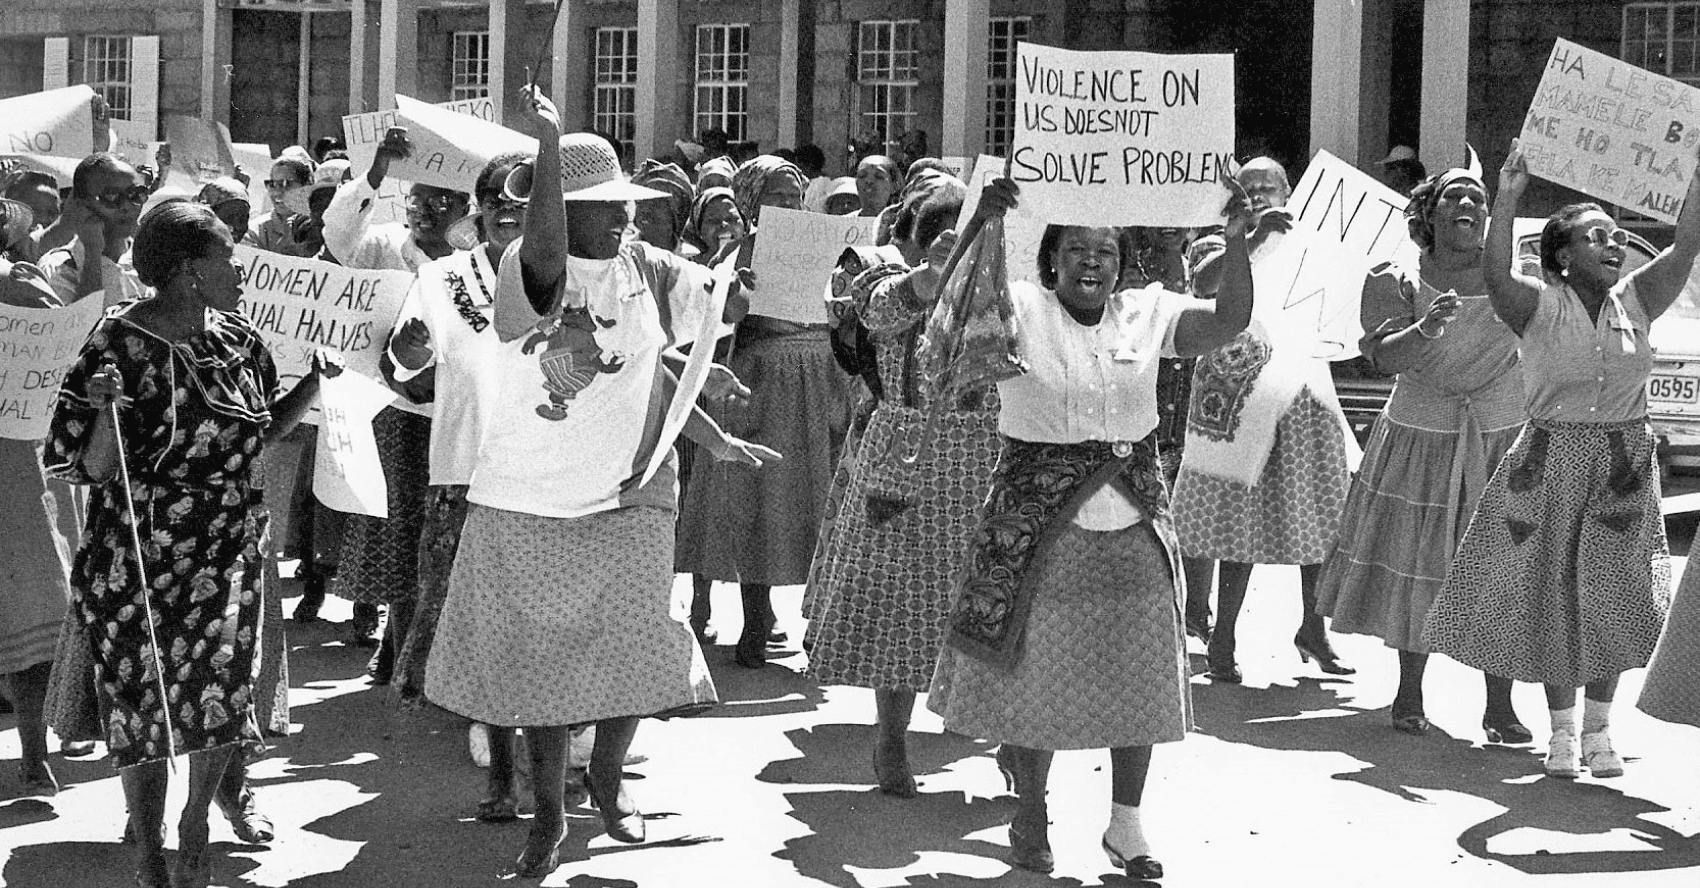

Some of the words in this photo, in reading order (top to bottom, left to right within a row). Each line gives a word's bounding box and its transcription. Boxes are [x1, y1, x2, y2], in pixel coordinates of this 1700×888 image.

[1022, 55, 1147, 103] VIOLENCE
[1162, 69, 1200, 107] ON
[1550, 46, 1585, 80] HA
[1024, 102, 1058, 132] US
[1014, 146, 1108, 186] SOLVE
[1575, 127, 1610, 155] HO
[1630, 141, 1684, 182] TLA
[334, 276, 382, 312] ARE
[294, 308, 374, 352] HALVES
[1650, 377, 1694, 399] 0595
